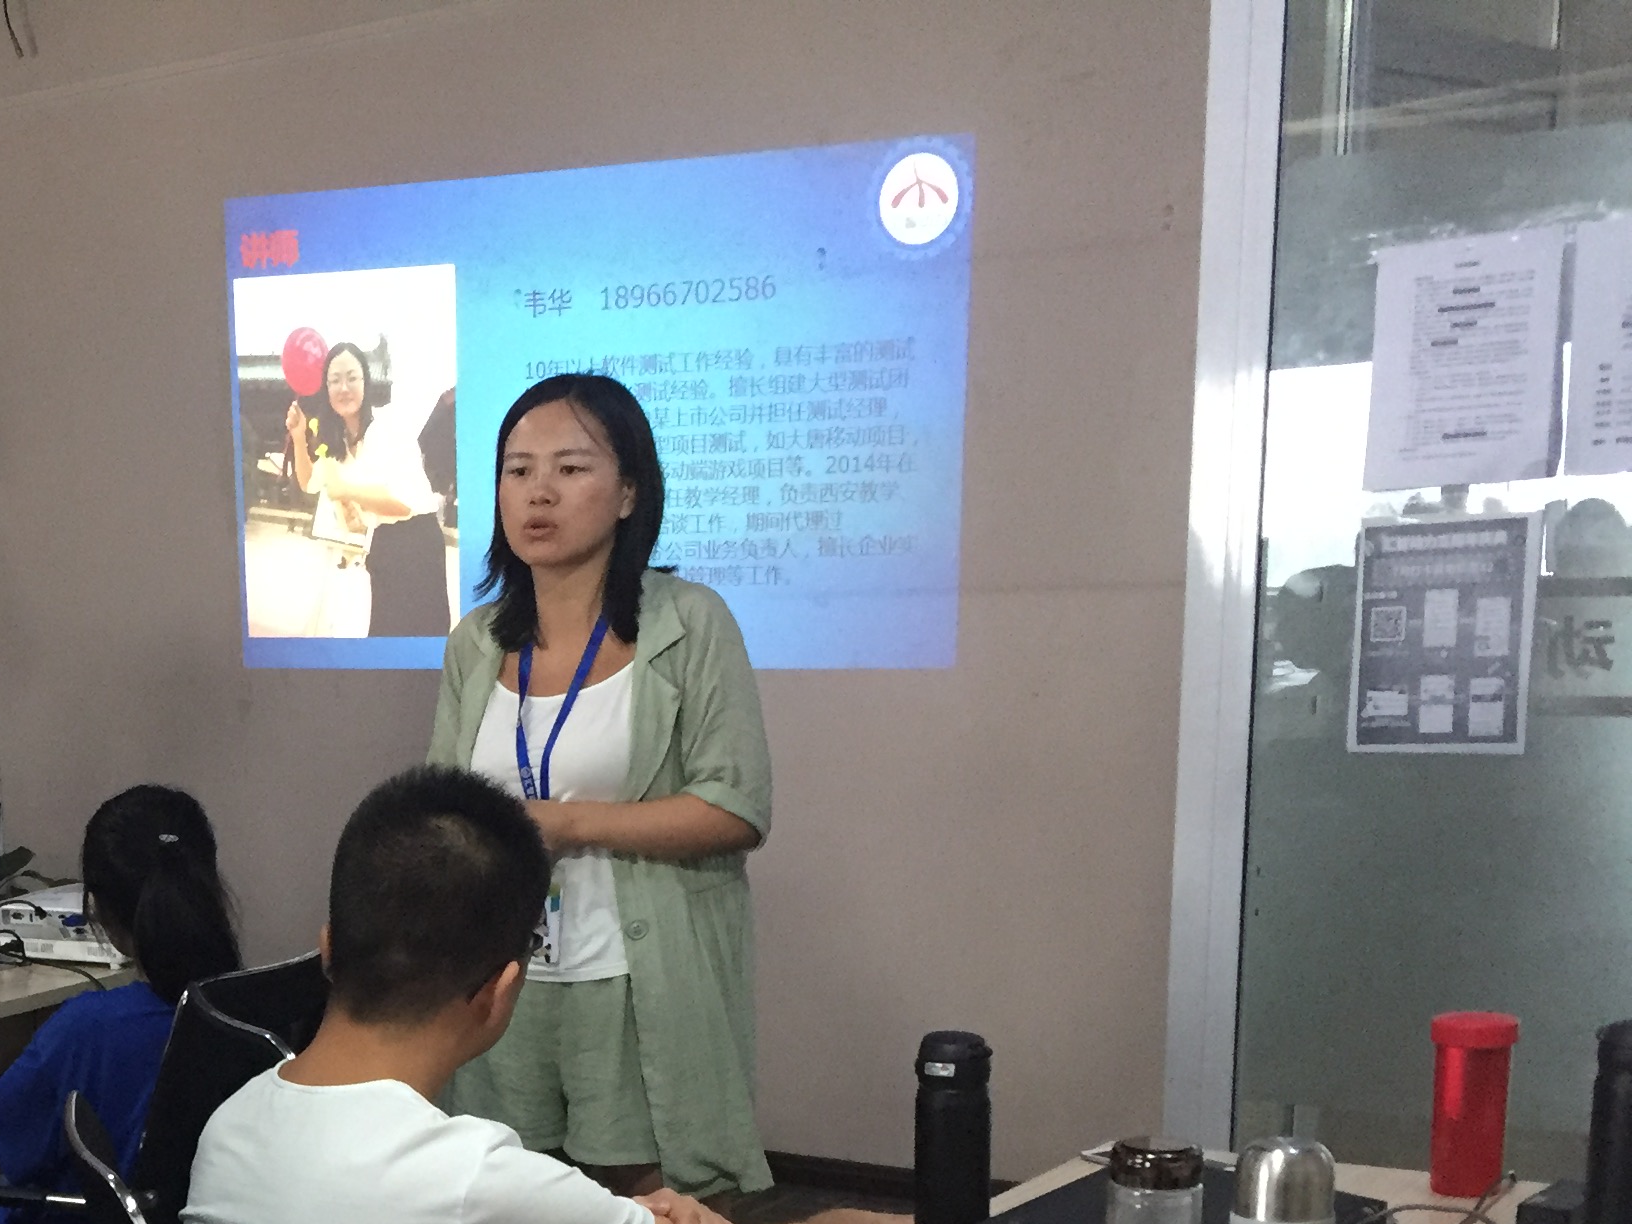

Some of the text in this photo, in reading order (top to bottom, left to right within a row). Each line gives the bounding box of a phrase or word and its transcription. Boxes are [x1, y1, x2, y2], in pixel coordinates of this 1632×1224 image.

[525, 274, 777, 318] 韦华 18966702586
[626, 367, 909, 403] 测试经验。擅长组建大型测试团
[648, 396, 899, 430] 某上市公司并担任测试经理，
